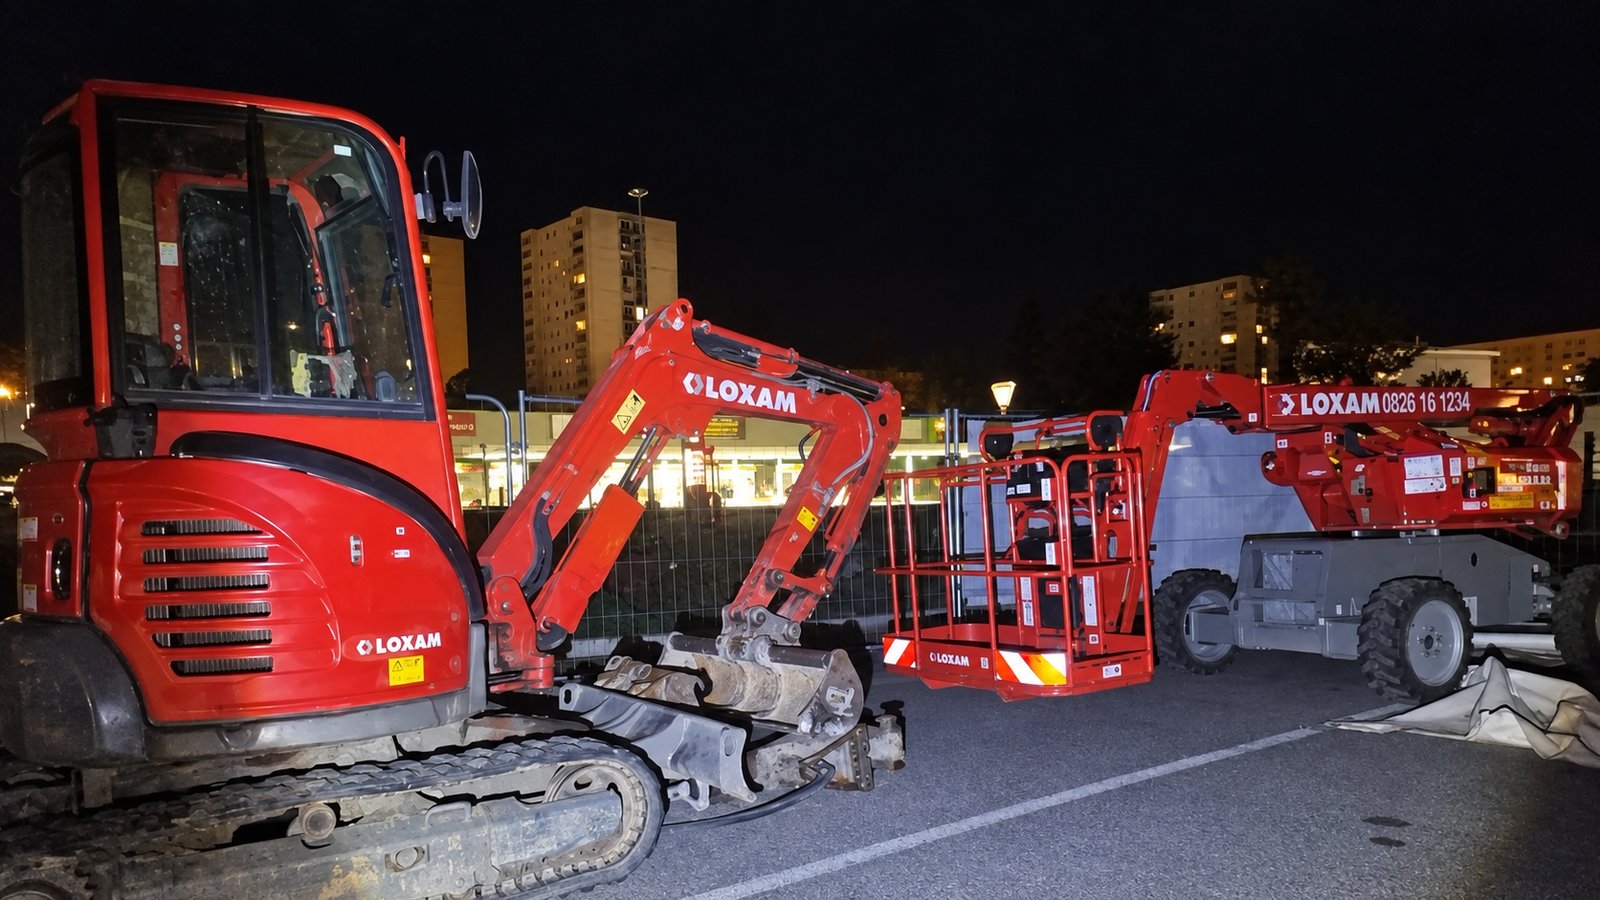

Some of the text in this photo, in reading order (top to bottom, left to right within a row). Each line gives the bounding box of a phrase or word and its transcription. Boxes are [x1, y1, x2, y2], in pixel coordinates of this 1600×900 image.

[706, 375, 796, 413] LOXAM
[1301, 391, 1470, 415] LOXAM 0826 16 1234
[376, 632, 441, 654] LOXAM
[937, 653, 969, 667] LOXAM
